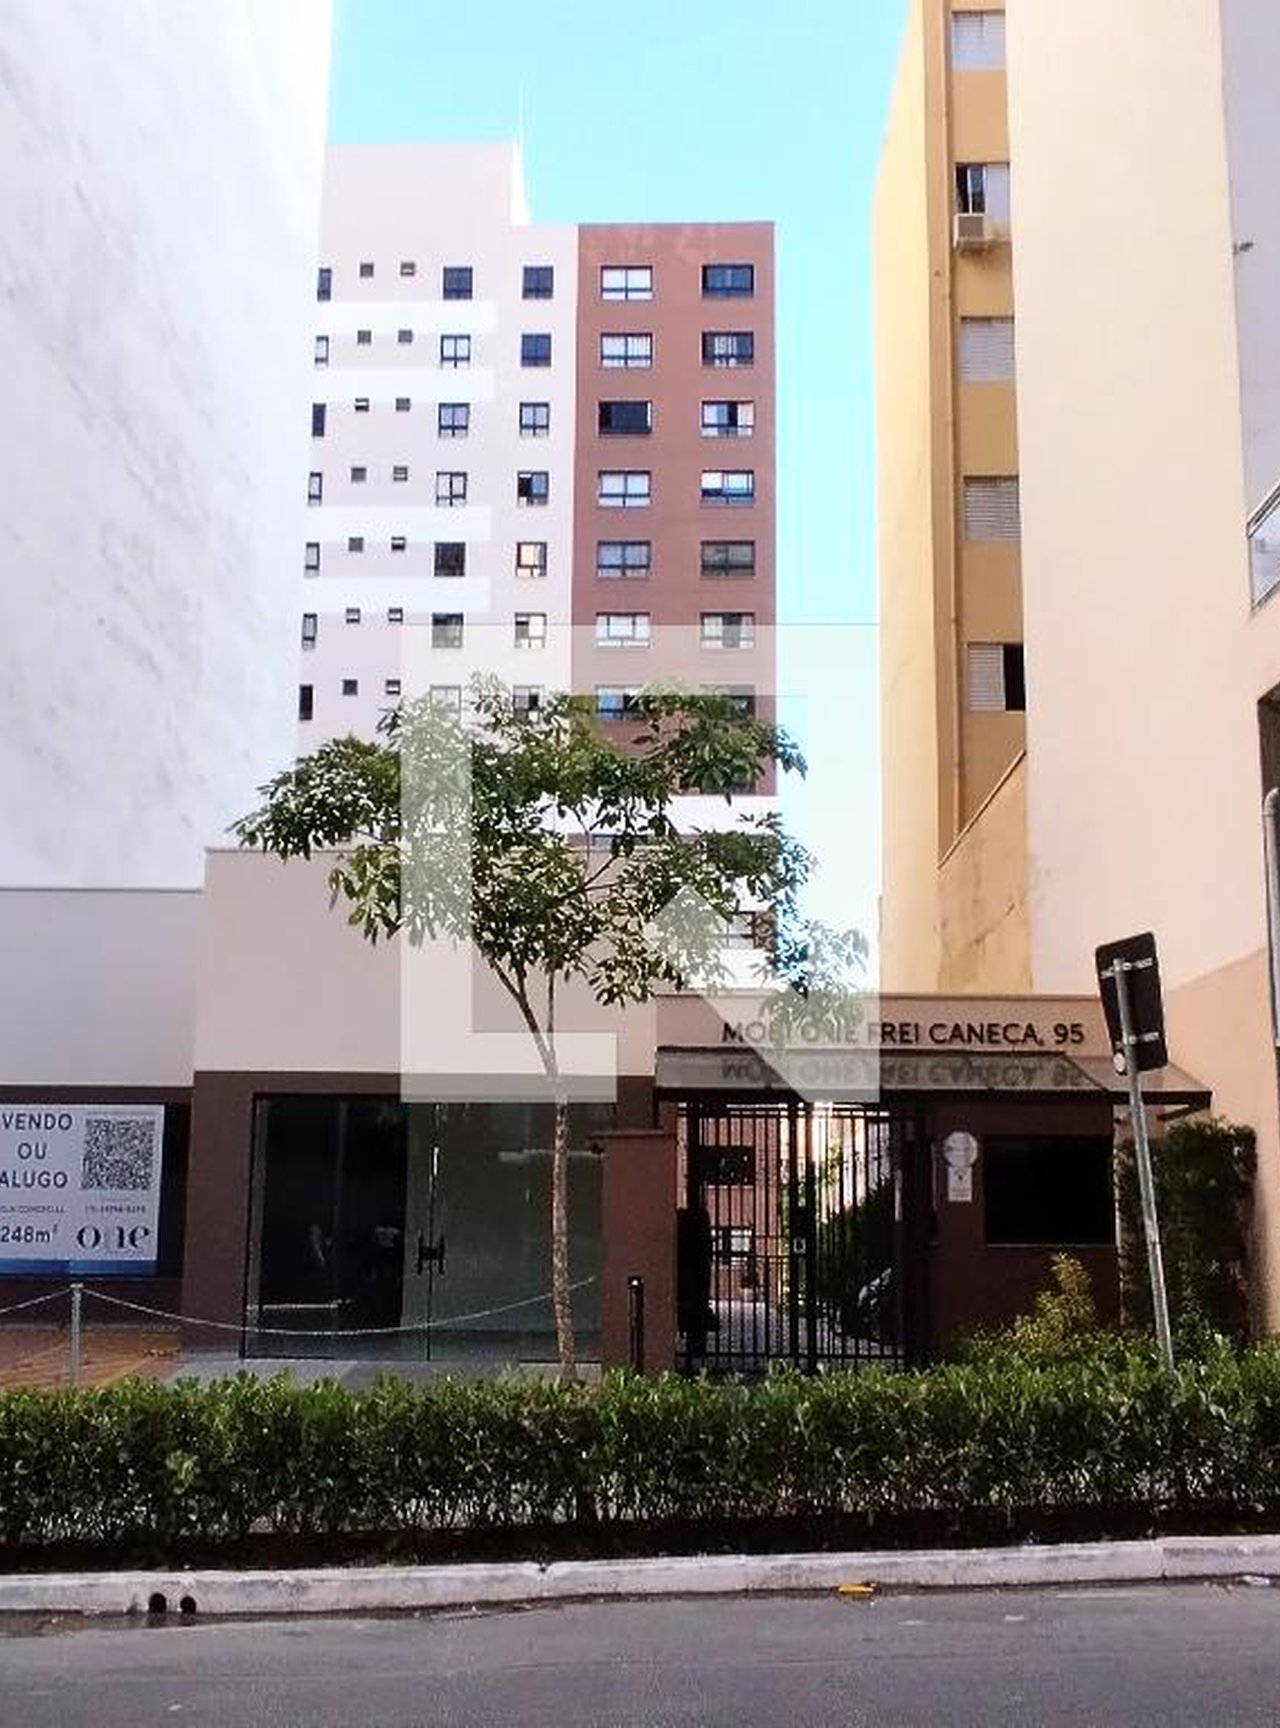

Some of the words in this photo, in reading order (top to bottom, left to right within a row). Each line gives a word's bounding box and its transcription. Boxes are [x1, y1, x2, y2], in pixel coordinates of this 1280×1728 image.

[867, 1022, 919, 1044] FREI
[928, 1022, 1045, 1047] CANECA,
[1053, 1023, 1086, 1045] 95
[1, 1112, 73, 1131] VENDO
[17, 1142, 48, 1160] OU
